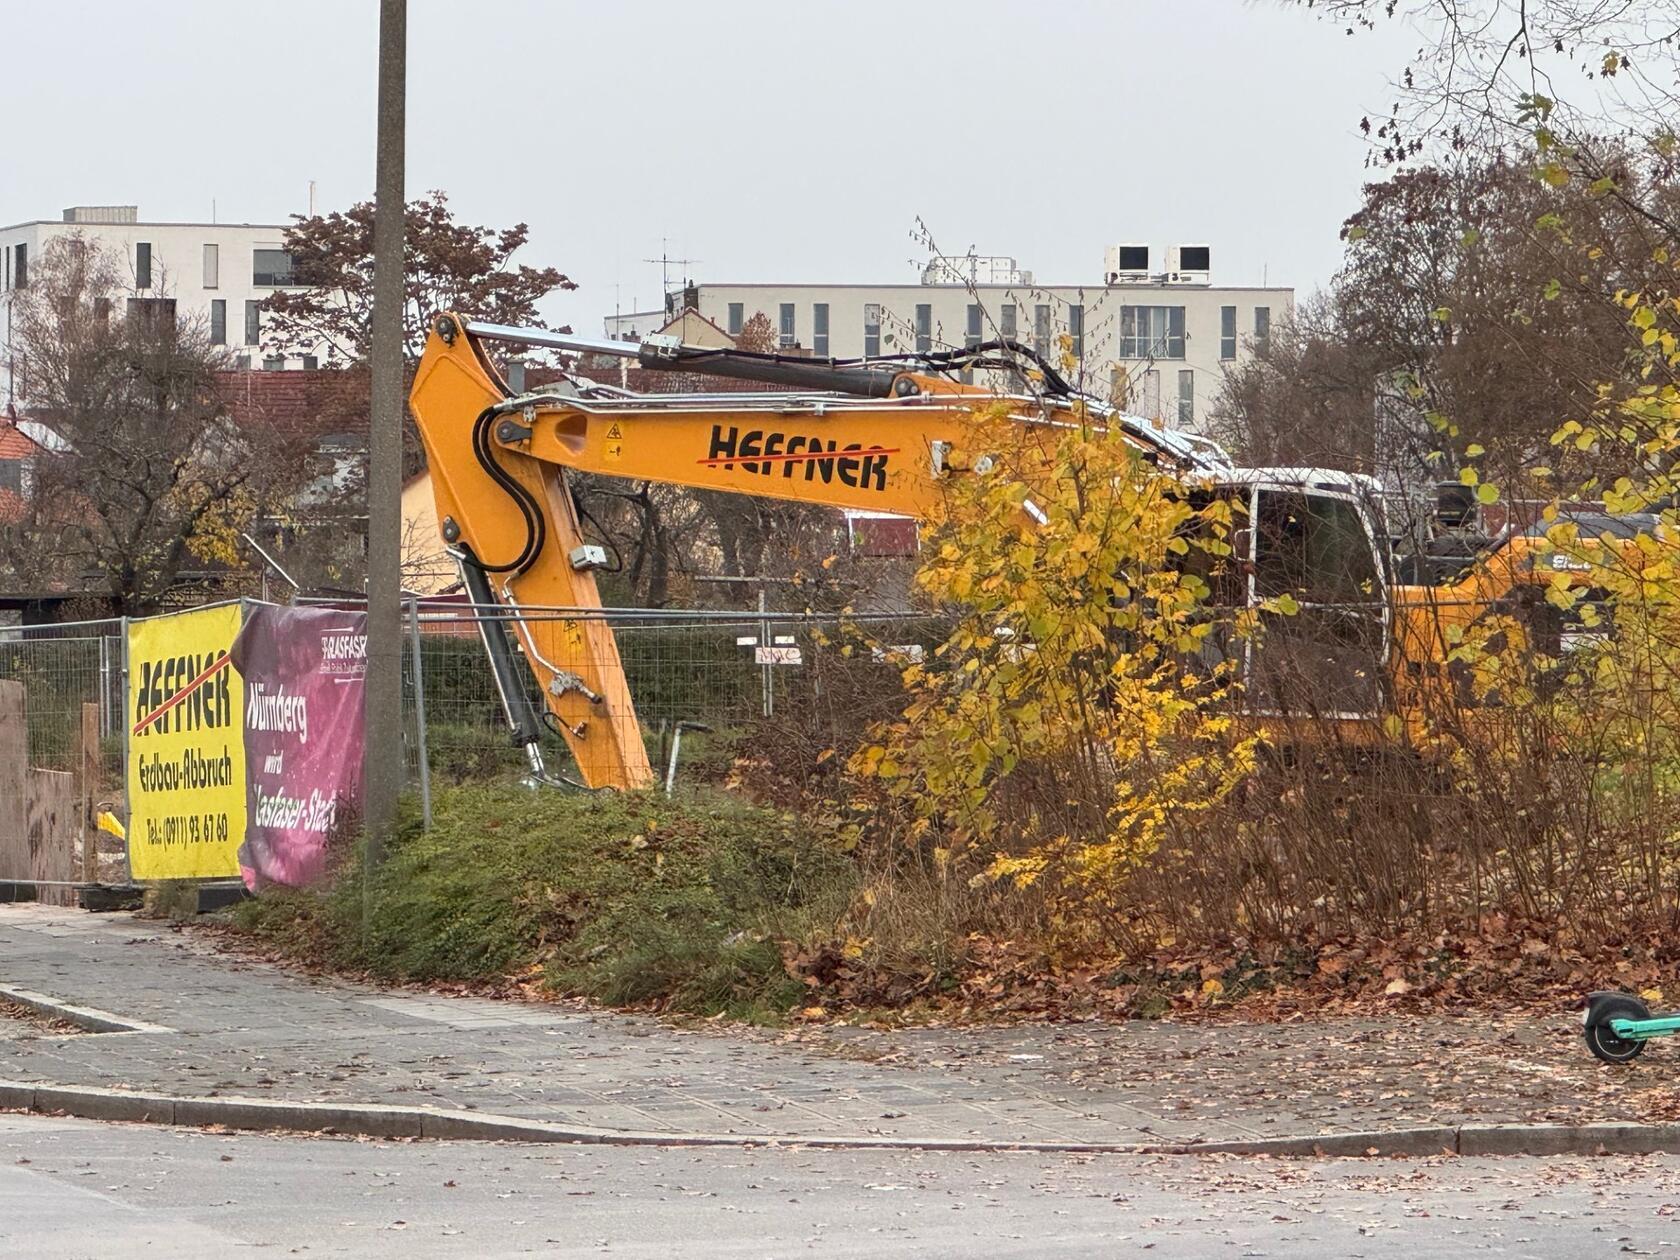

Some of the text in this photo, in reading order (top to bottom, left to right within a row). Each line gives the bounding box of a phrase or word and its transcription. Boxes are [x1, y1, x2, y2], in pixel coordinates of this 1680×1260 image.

[708, 425, 888, 491] HEFFNER
[134, 649, 230, 736] HEFFNER
[247, 682, 307, 744] Nürnberg
[139, 744, 232, 792] Erdbau-Abbruch
[264, 749, 283, 774] wird
[163, 815, 187, 852] (0911)
[189, 815, 200, 843] 93
[203, 814, 214, 842] 67
[216, 812, 228, 842] 60
[253, 784, 338, 833] lasfaser-Sta
